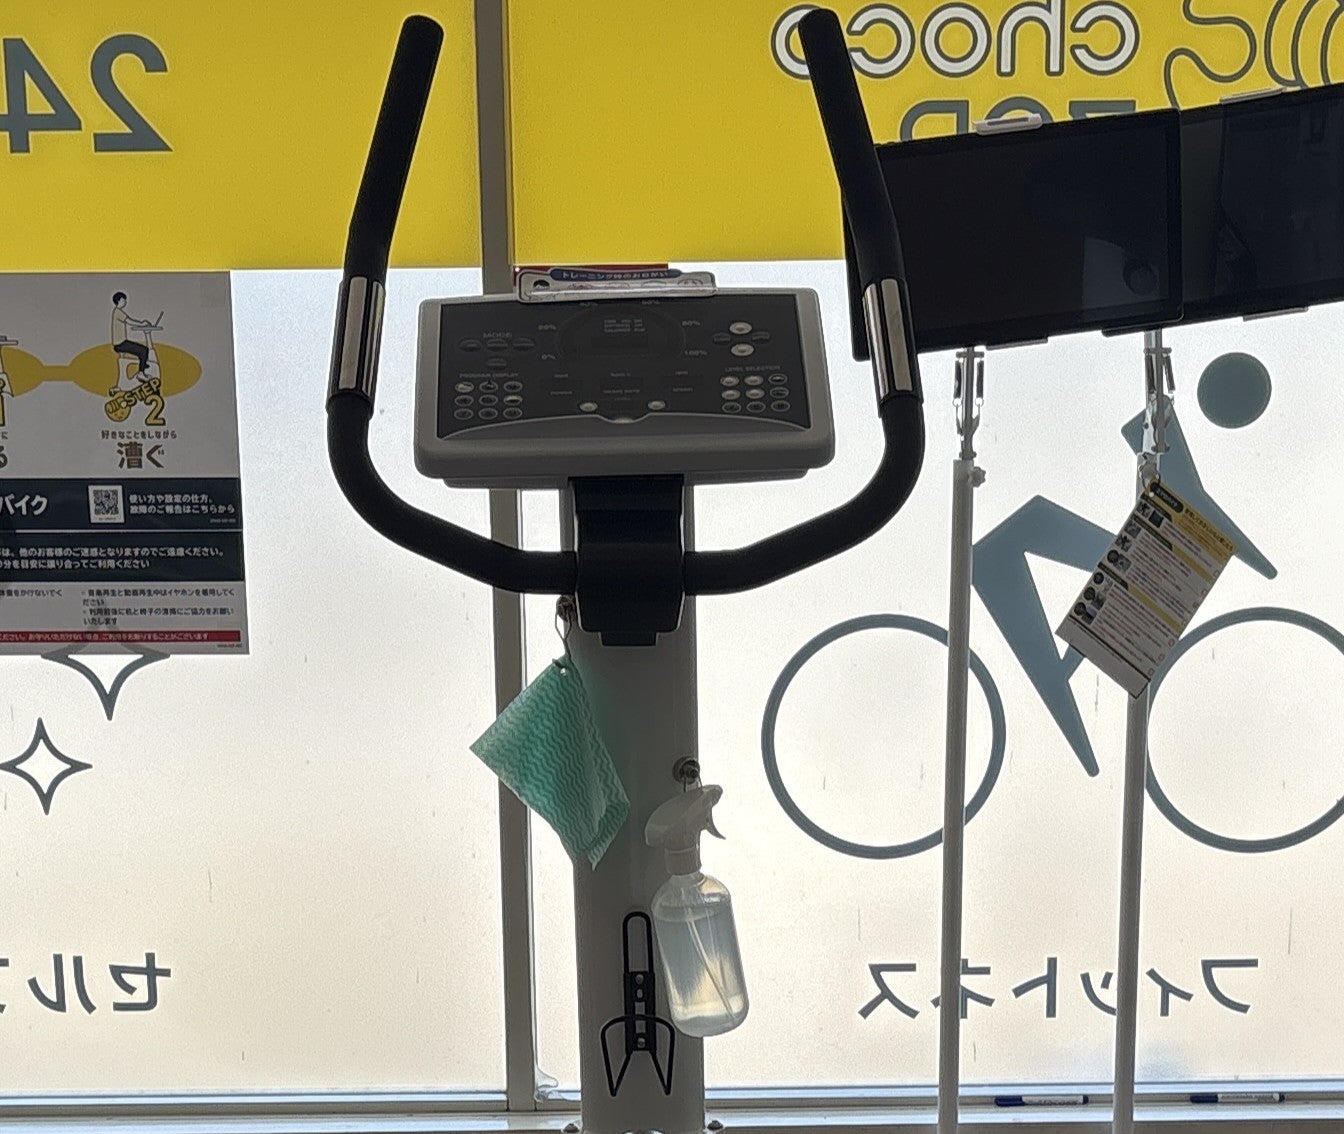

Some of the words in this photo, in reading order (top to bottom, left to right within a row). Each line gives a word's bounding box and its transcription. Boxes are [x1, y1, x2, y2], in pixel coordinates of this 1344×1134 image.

[123, 377, 161, 406] STEP
[145, 395, 166, 426] 2
[101, 430, 177, 439] 好きなことをしながら
[117, 441, 165, 469] 漕ぐ
